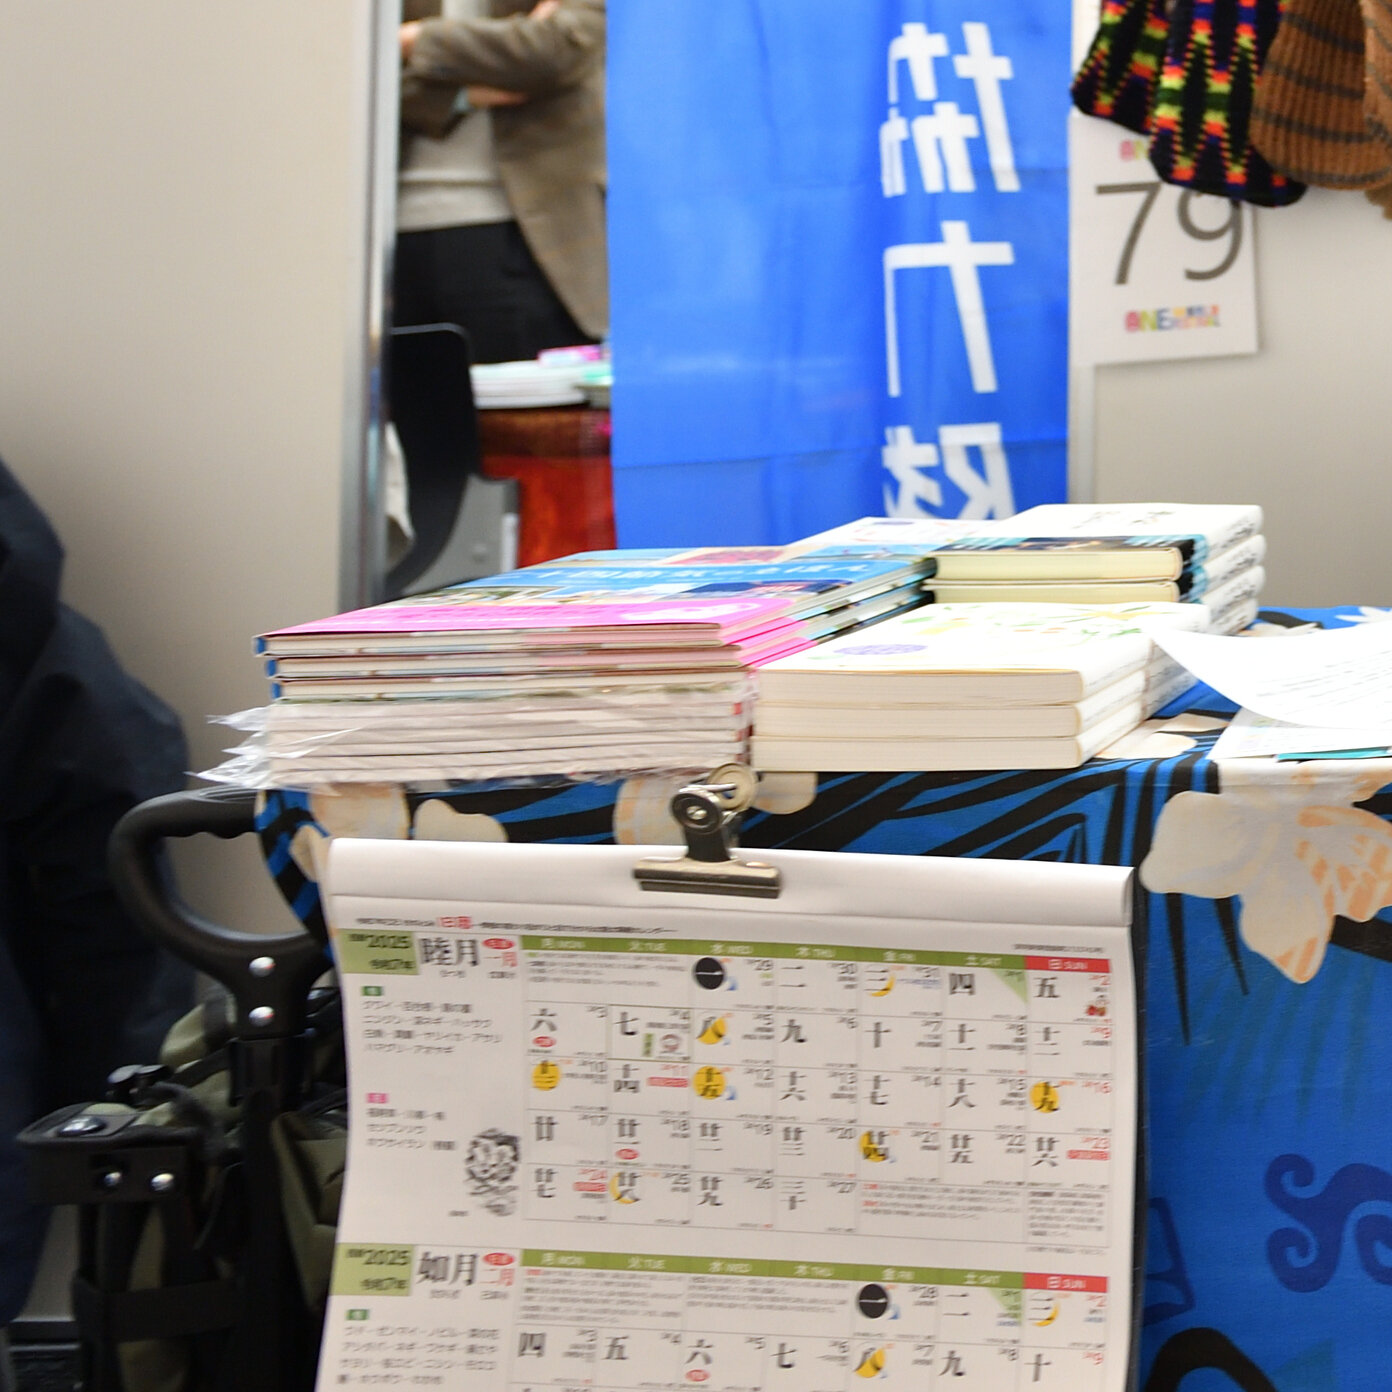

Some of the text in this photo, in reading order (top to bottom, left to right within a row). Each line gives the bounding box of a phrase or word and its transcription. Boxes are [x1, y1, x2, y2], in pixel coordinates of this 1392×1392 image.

[1095, 181, 1244, 286] 79
[420, 938, 478, 966] 睦月
[1033, 977, 1060, 998] 五
[531, 1008, 557, 1031] 六
[614, 1012, 639, 1035] 七
[781, 1019, 806, 1043] 九
[865, 1022, 891, 1048] 十
[417, 1252, 479, 1286] 如月
[603, 1336, 630, 1360] 五
